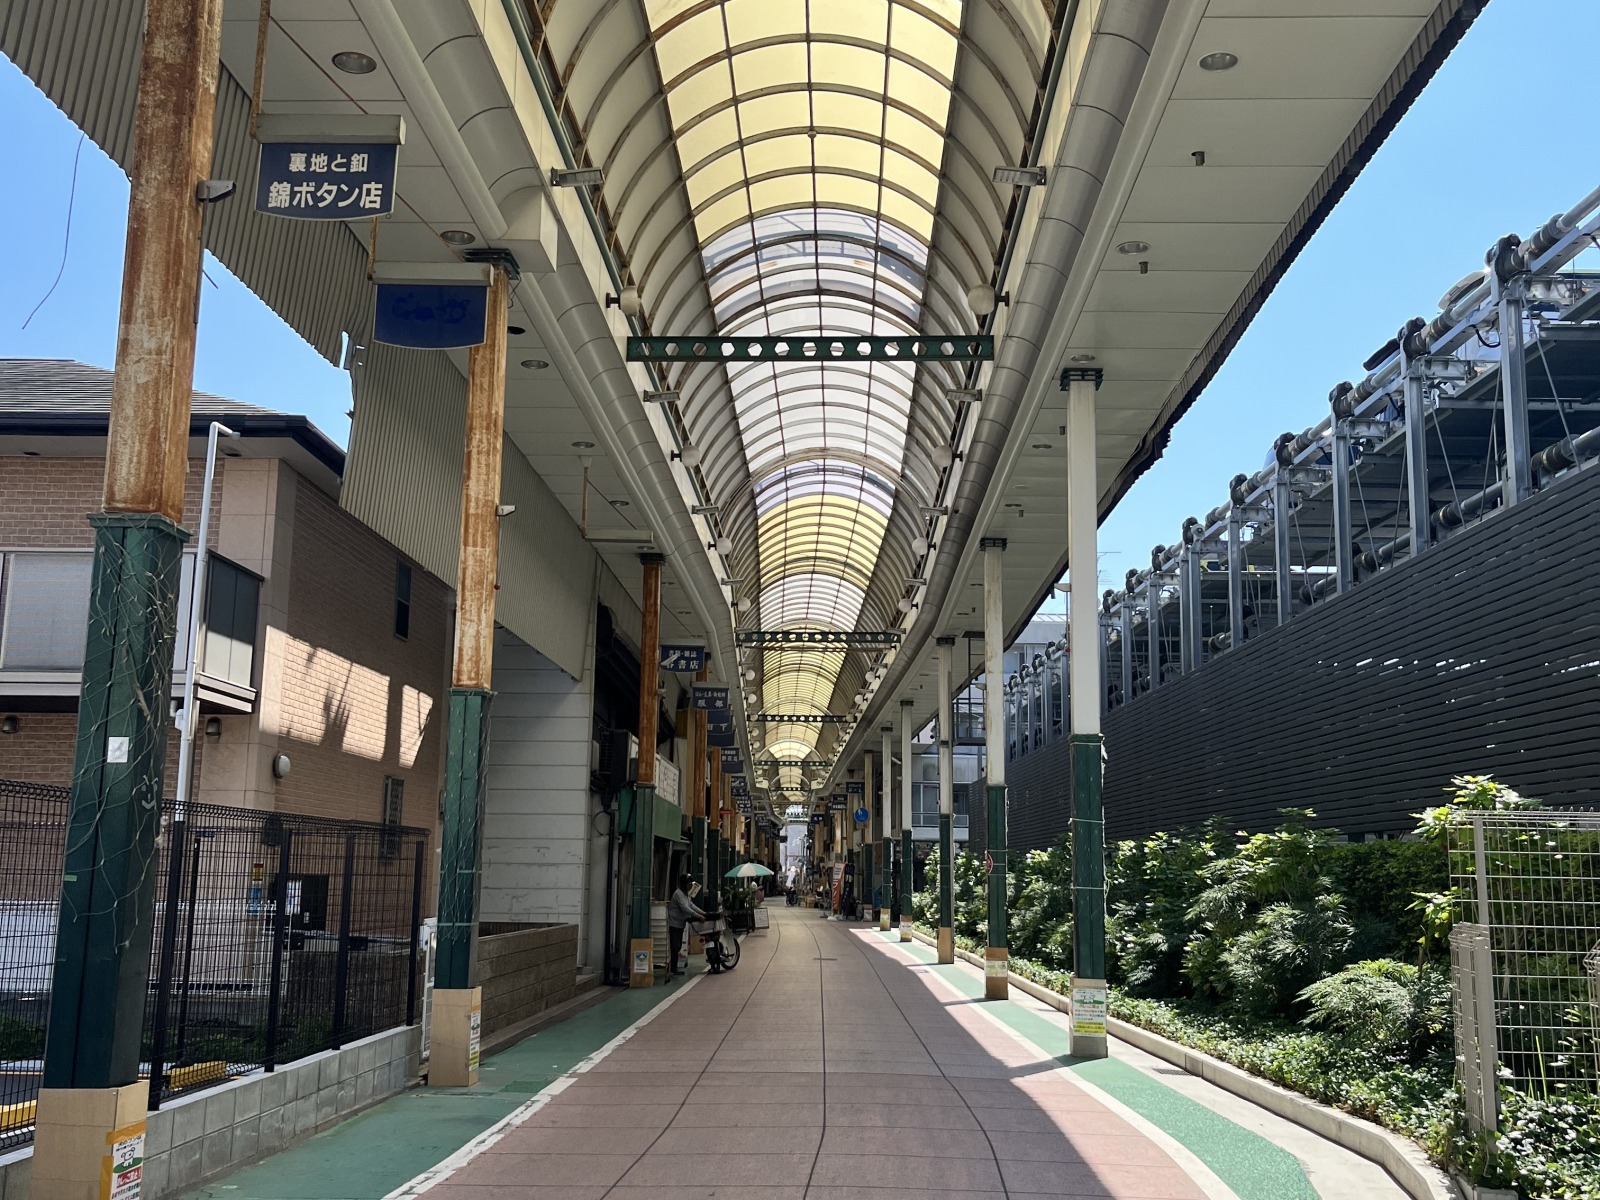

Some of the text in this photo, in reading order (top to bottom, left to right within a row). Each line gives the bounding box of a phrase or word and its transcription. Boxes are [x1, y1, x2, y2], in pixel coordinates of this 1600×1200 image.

[289, 153, 369, 173] 裏地と釦
[267, 182, 383, 209] 錦ボタン店
